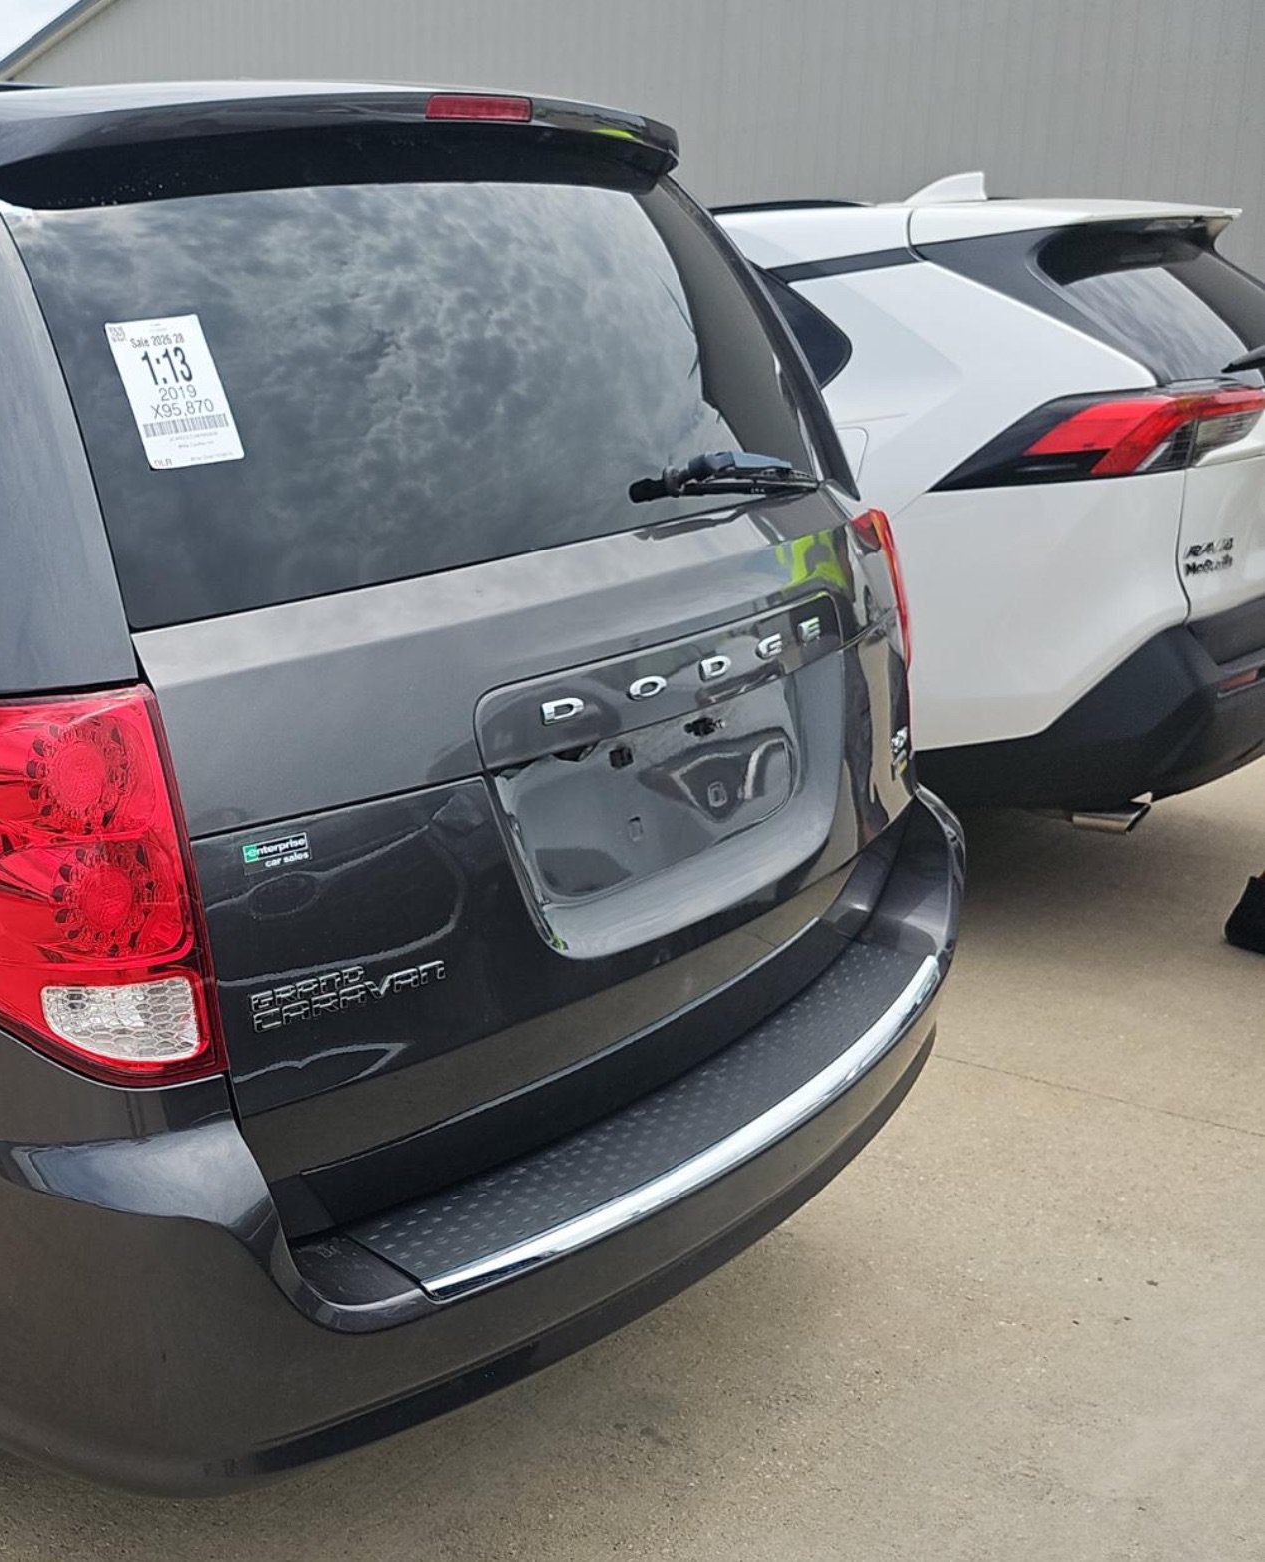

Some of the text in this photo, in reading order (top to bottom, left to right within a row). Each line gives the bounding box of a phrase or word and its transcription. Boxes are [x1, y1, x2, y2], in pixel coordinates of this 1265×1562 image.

[130, 337, 150, 349] Sale
[141, 346, 193, 386] 1:13
[158, 384, 197, 402] 2019
[540, 616, 822, 725] DODGE
[246, 837, 306, 857] enterprise
[264, 851, 310, 868] car sales
[249, 965, 365, 1012] GRAND
[252, 960, 447, 1033] CARAVAN
